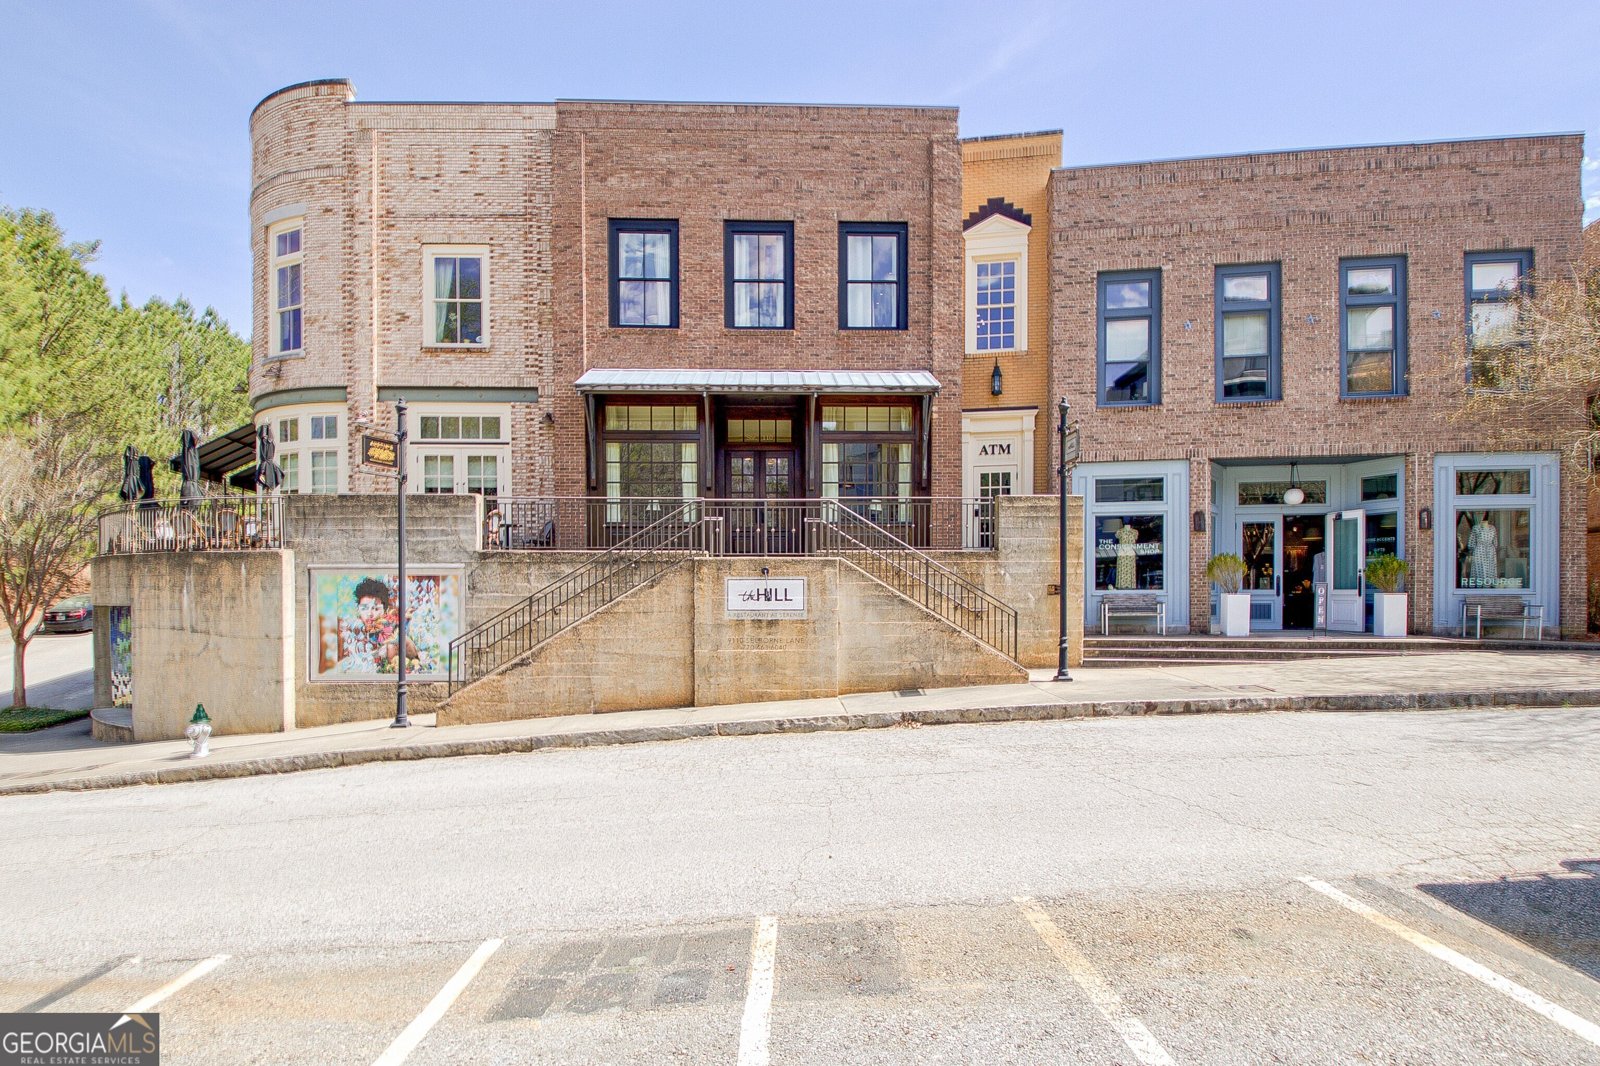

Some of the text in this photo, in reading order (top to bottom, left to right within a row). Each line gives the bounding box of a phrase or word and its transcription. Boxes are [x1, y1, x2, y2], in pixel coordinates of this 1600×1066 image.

[979, 443, 1012, 456] ATM
[1461, 578, 1523, 586] RESOURCE
[756, 588, 793, 602] HILL
[1317, 587, 1325, 624] OPEN
[728, 637, 744, 645] 9110
